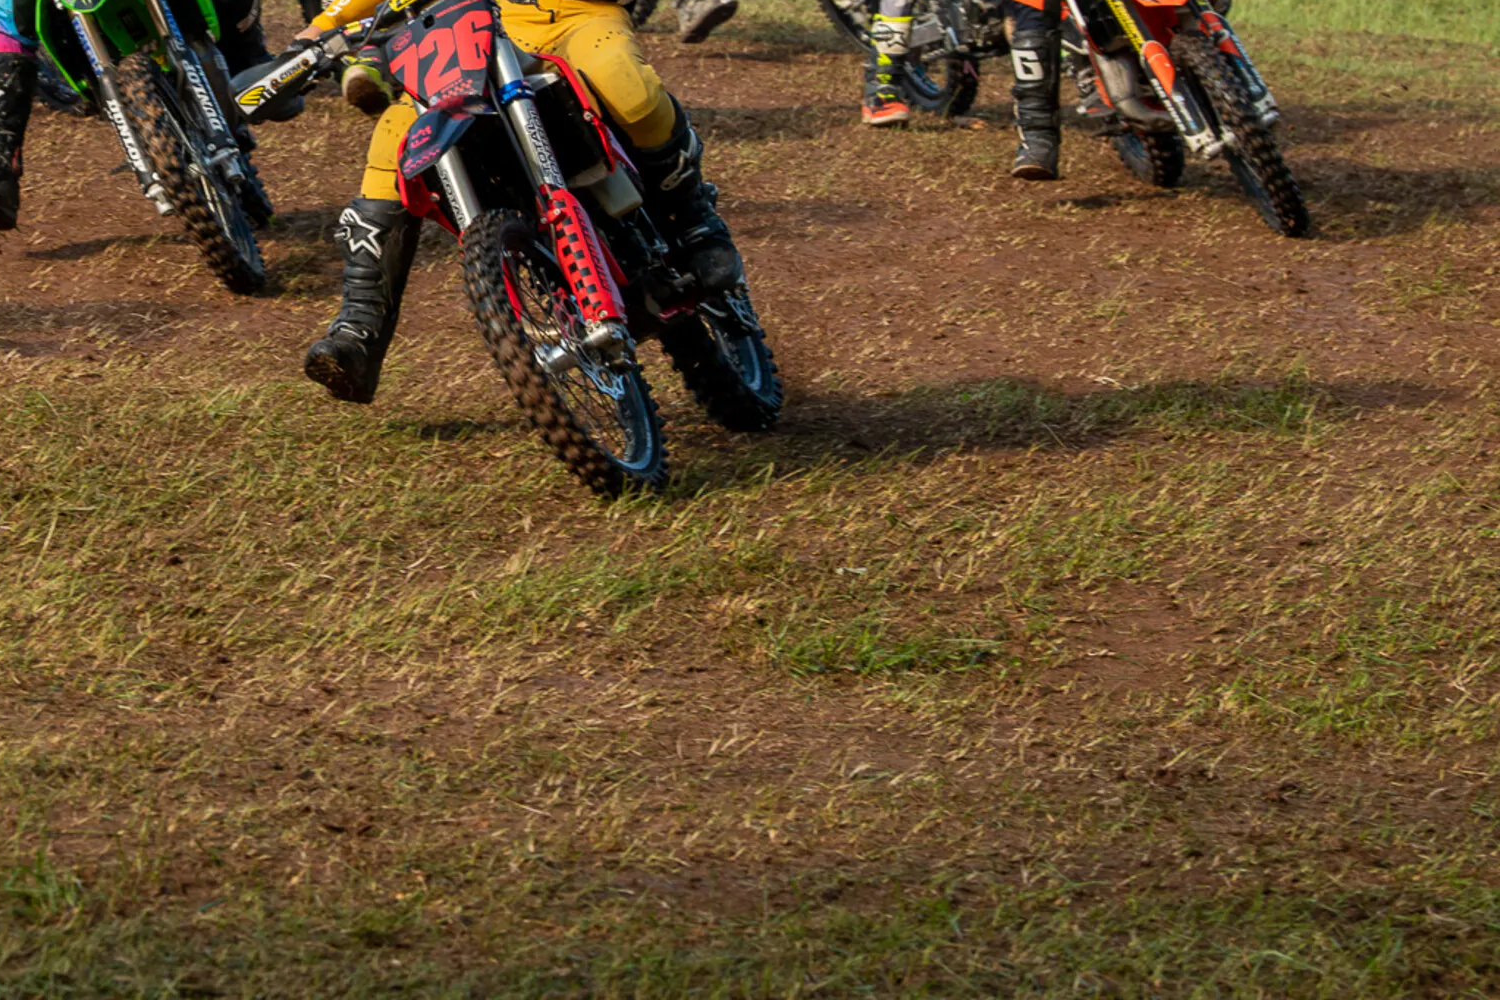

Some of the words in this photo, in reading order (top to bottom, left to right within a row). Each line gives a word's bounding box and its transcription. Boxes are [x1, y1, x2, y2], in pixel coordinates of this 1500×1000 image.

[389, 10, 492, 100] 726
[107, 99, 147, 173] DUNLOP
[524, 121, 553, 177] TOTAL
